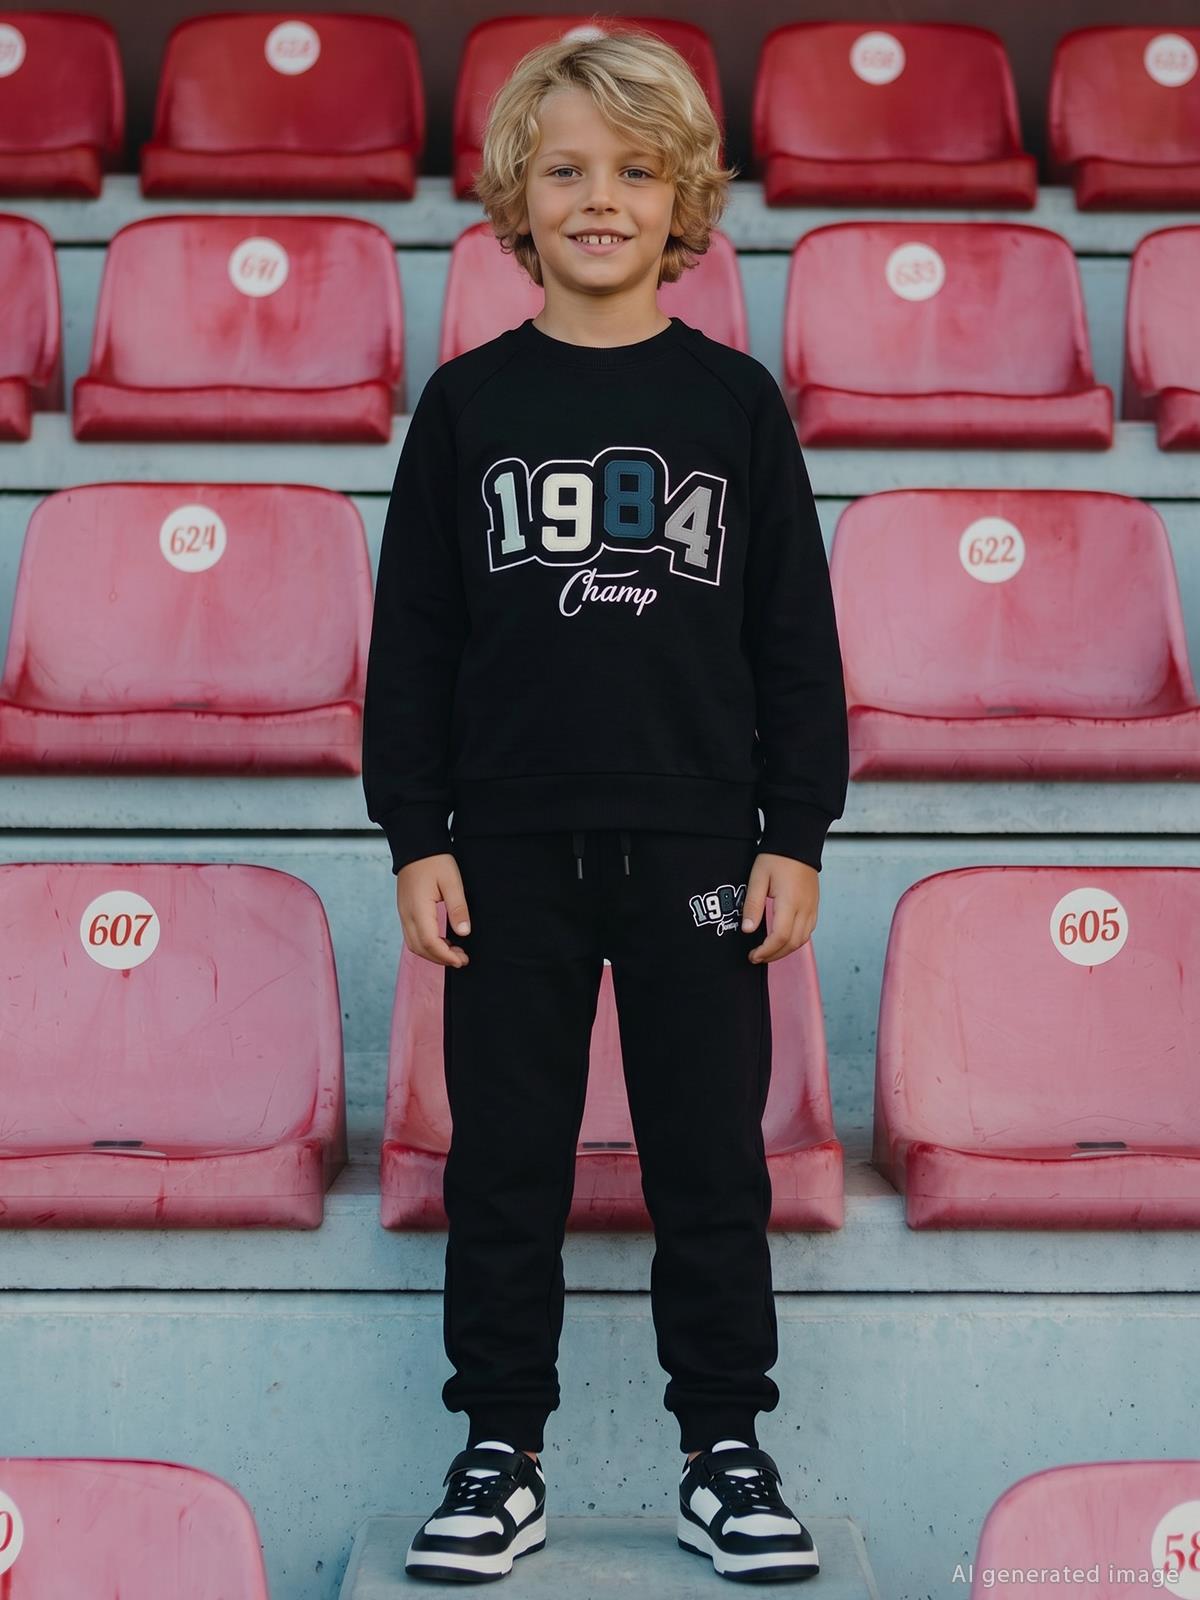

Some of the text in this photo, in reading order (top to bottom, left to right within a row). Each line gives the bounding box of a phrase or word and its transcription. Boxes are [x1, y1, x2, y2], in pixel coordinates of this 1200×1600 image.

[493, 460, 713, 569] 1984
[169, 523, 216, 556] 624
[967, 535, 1016, 566] 622
[558, 567, 658, 618] Champ
[88, 913, 153, 947] 607
[1059, 907, 1120, 946] 605
